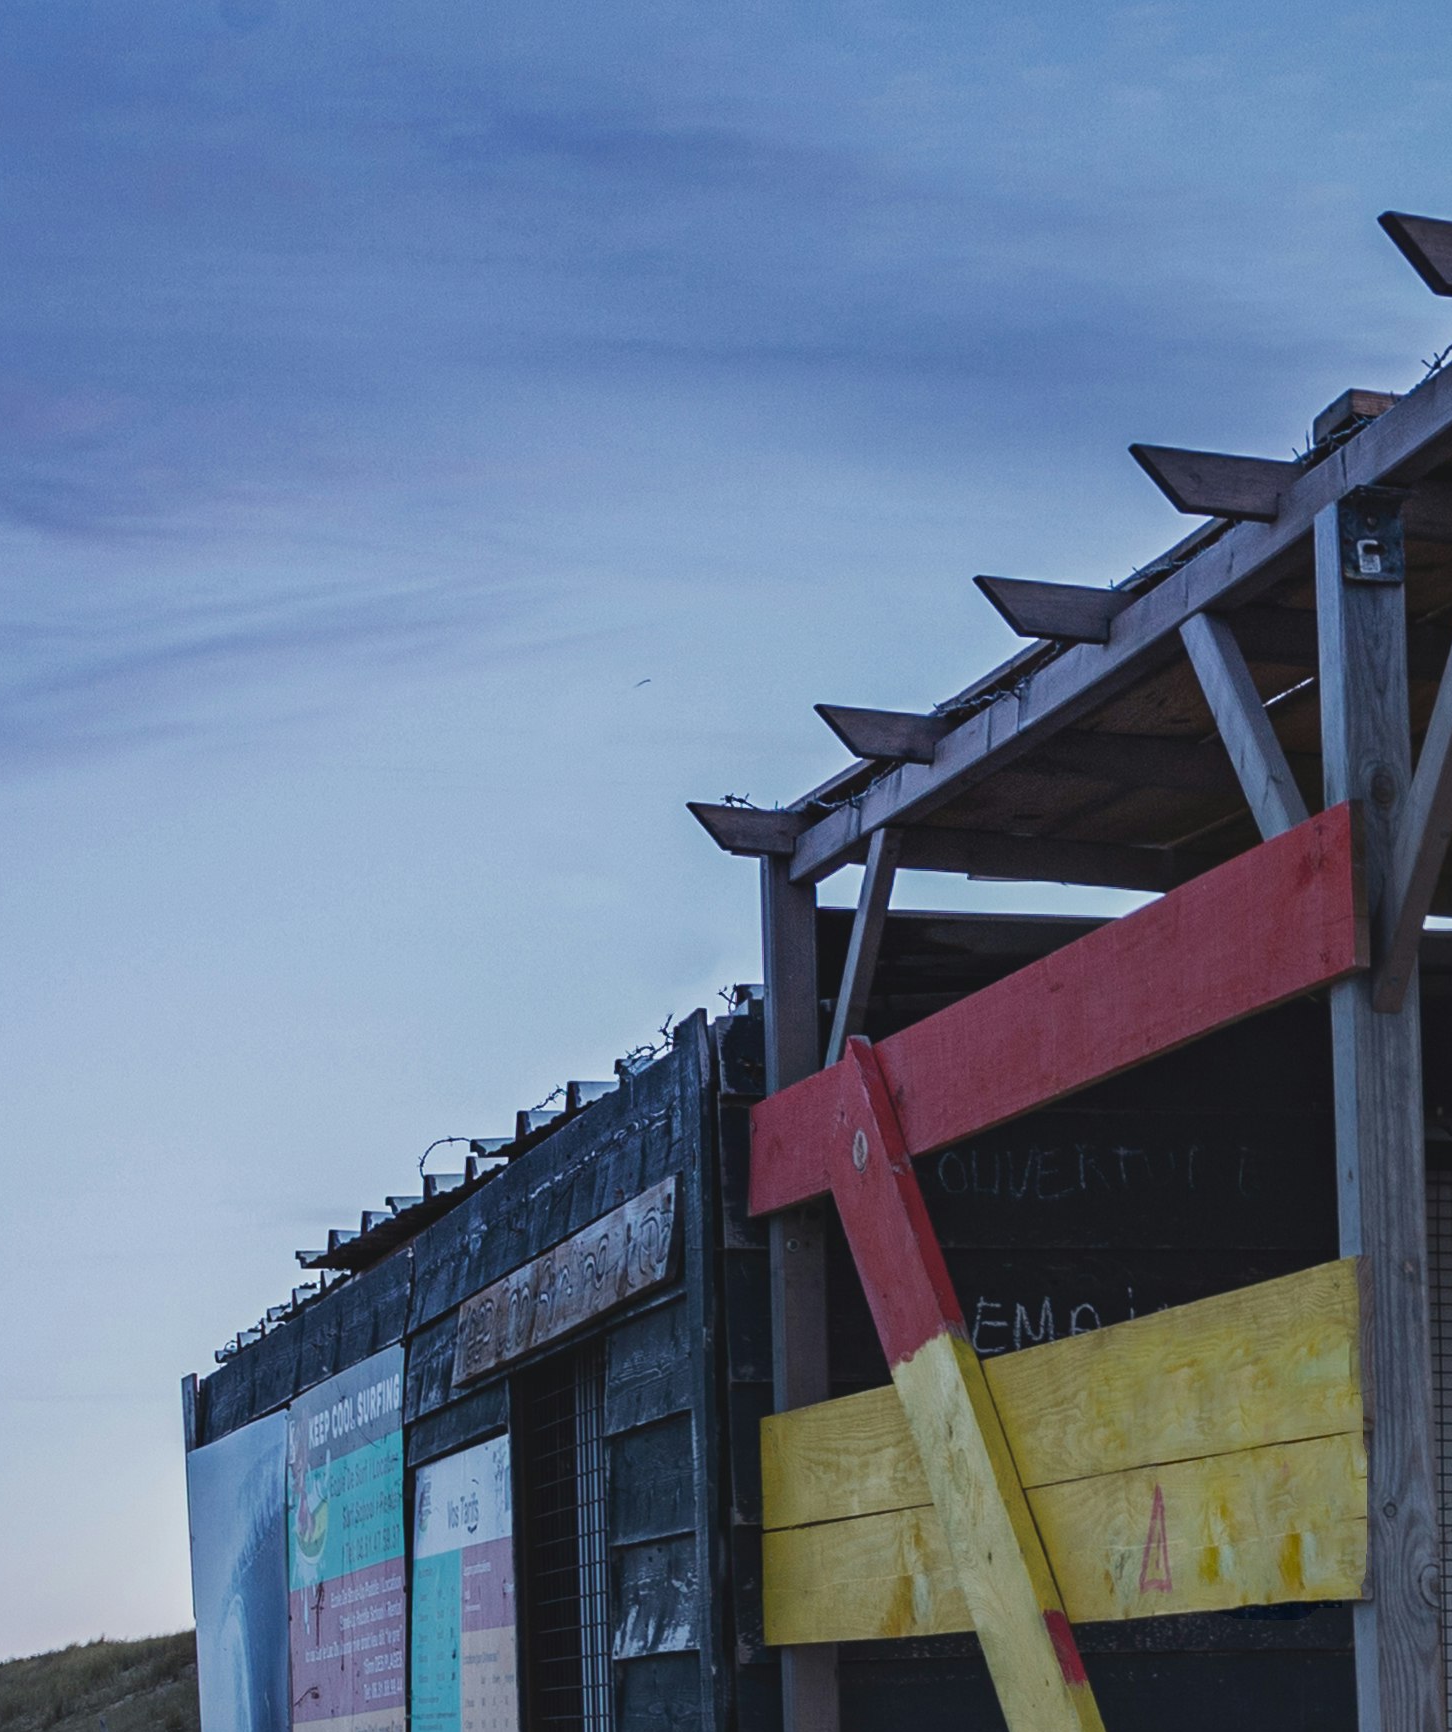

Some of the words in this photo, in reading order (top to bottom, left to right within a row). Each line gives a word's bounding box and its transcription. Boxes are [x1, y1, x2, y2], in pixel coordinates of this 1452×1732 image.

[308, 1409, 330, 1450] KEEP
[332, 1397, 355, 1439] COOL
[357, 1373, 400, 1427] SURFING
[447, 1500, 460, 1529] Vos
